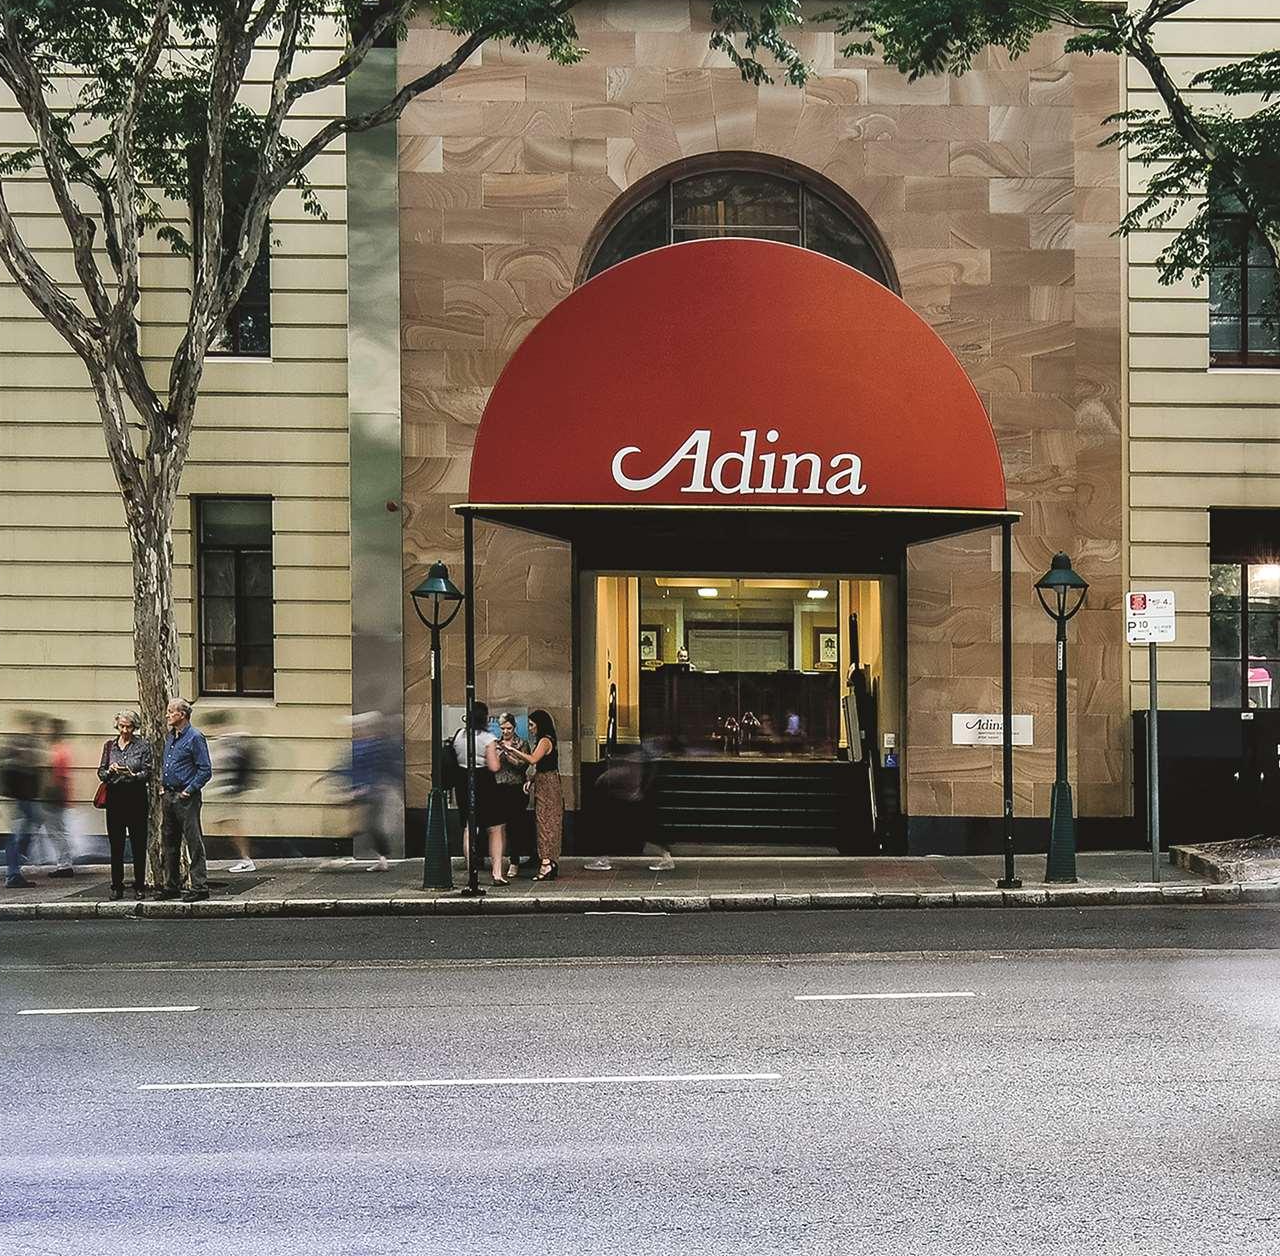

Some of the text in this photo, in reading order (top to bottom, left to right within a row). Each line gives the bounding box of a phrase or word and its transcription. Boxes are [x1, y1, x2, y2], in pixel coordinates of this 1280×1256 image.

[611, 429, 867, 495] Adina
[1128, 621, 1137, 633] P
[966, 719, 1003, 730] Adin
